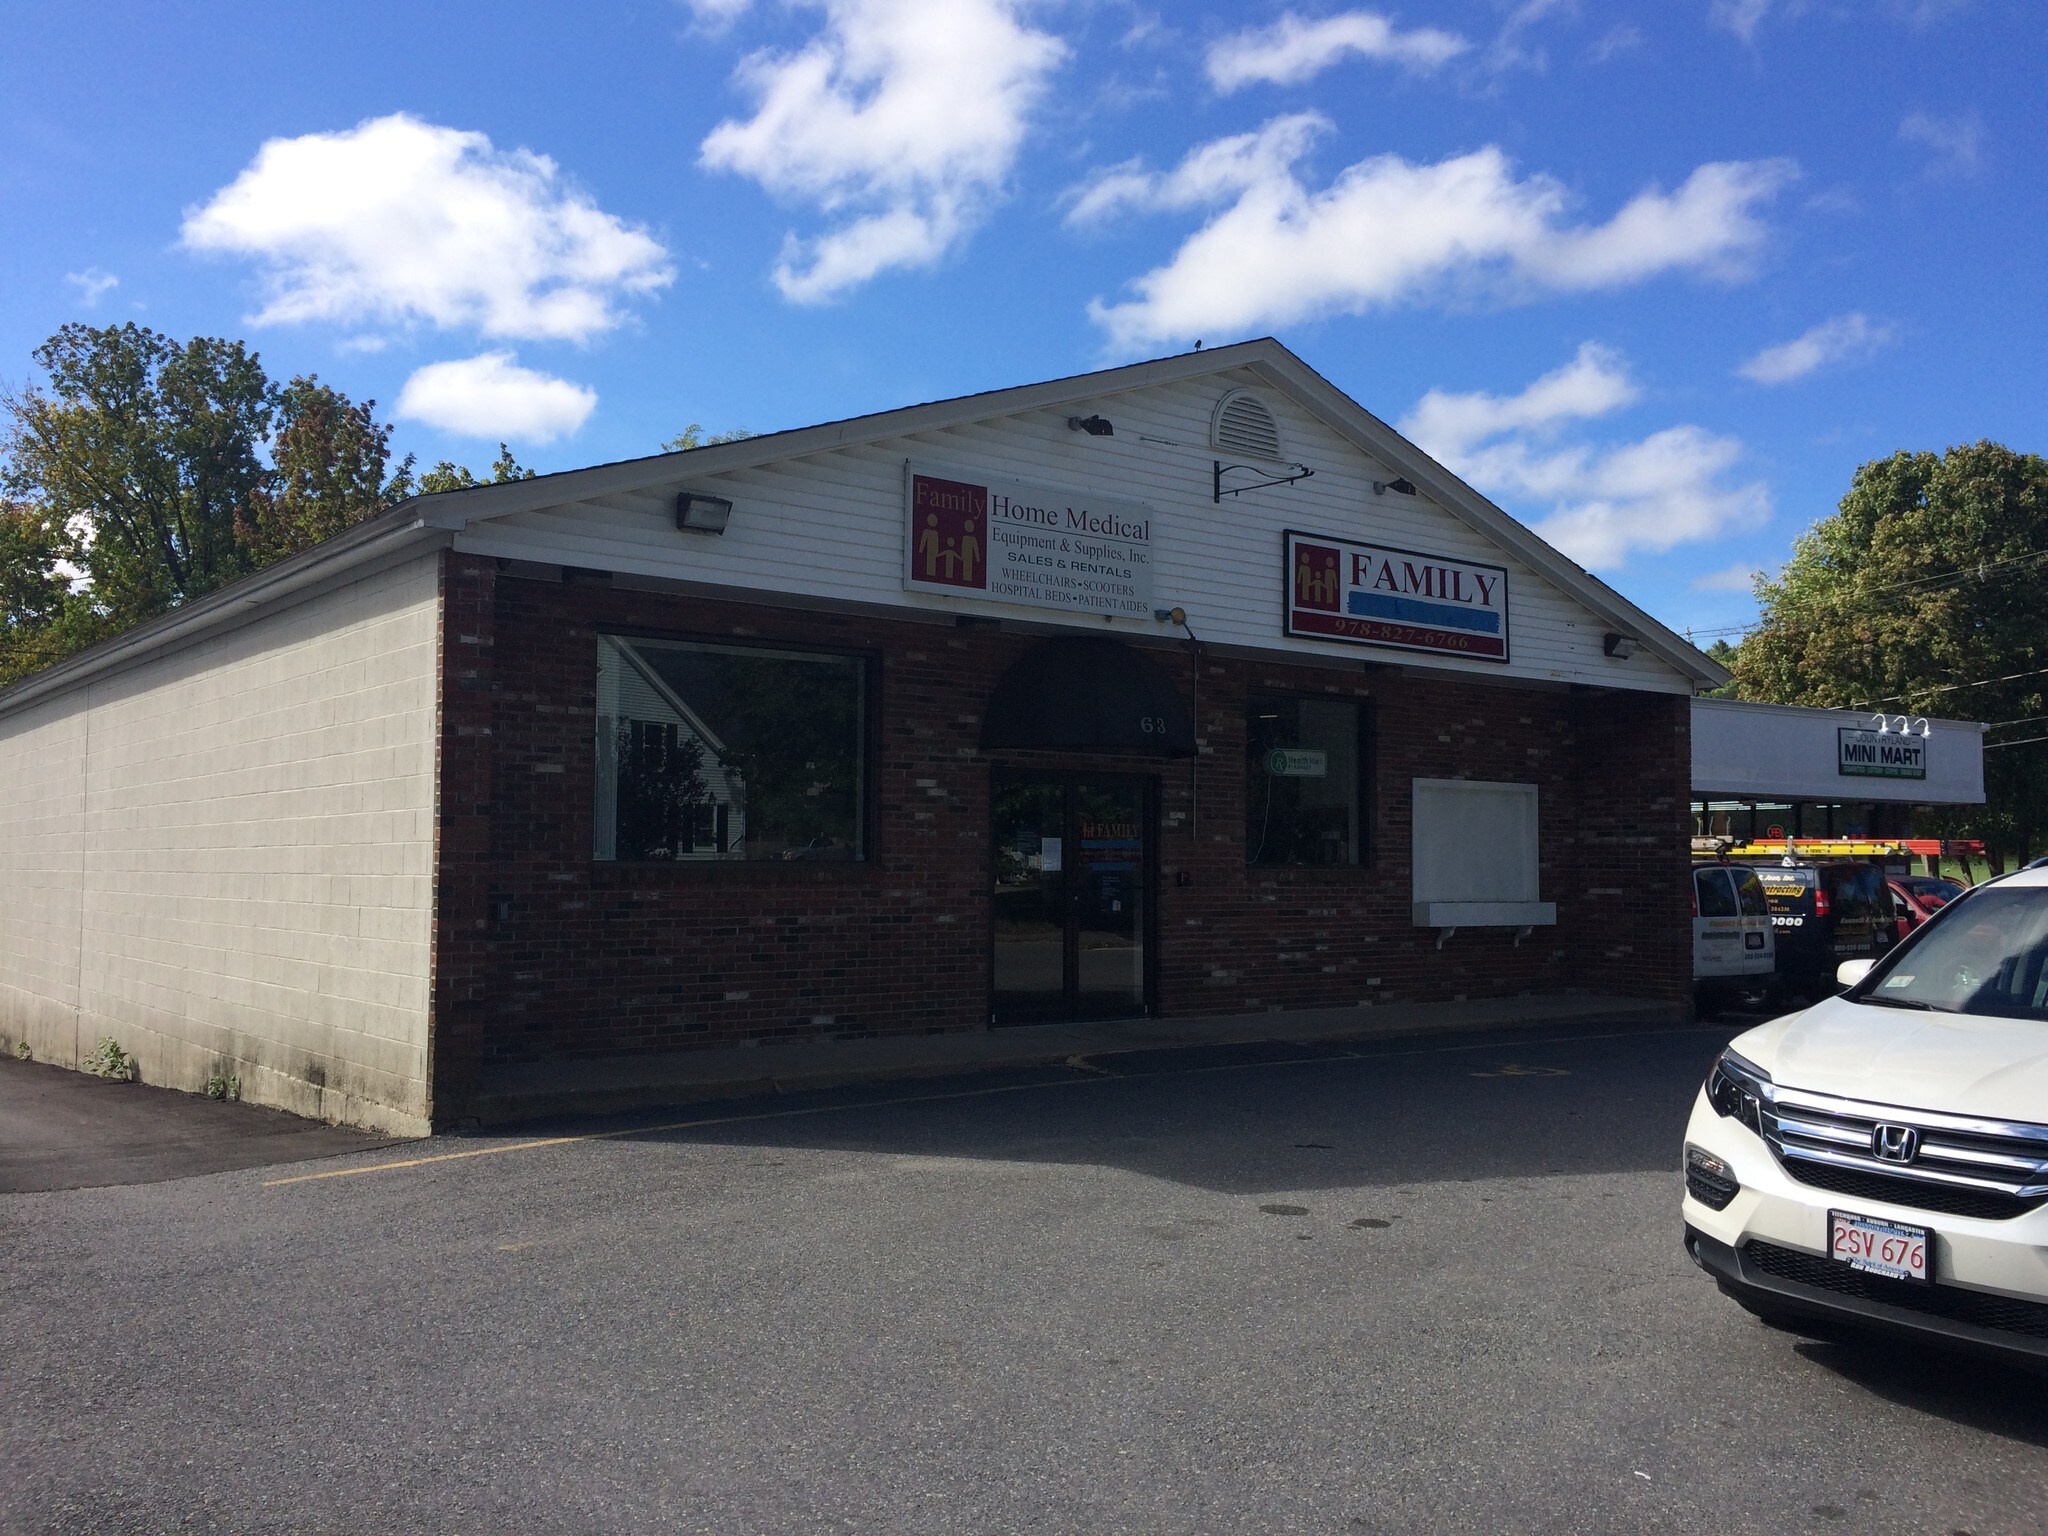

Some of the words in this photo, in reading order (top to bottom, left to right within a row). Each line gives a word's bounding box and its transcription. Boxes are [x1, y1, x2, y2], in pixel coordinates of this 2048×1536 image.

[915, 483, 985, 519] Family
[991, 495, 1058, 525] Home
[1066, 507, 1149, 540] Medical
[992, 527, 1057, 552] Equipment
[1059, 538, 1070, 552] &
[1074, 543, 1126, 562] Supplies,
[1129, 549, 1150, 565] Inc.
[1008, 552, 1053, 567] SALES
[1057, 559, 1067, 569] &
[1071, 561, 1132, 579] RENTALS
[1349, 552, 1498, 606] FAMILY
[991, 582, 1042, 599] HOSPITAL
[1045, 589, 1072, 603] BEDS
[1078, 594, 1119, 609] PATIENT
[1119, 599, 1149, 613] AIDES
[1335, 619, 1468, 649] 978-827-6766
[1140, 716, 1166, 734] 63
[1844, 744, 1876, 763] MINI
[1880, 746, 1921, 765] MART
[1097, 823, 1138, 838] FAMILY
[1866, 1218, 1889, 1227] AUBURN
[1893, 1223, 1925, 1236] LANCASTER
[1835, 1226, 1875, 1258] 2SV
[1881, 1238, 1924, 1269] 676
